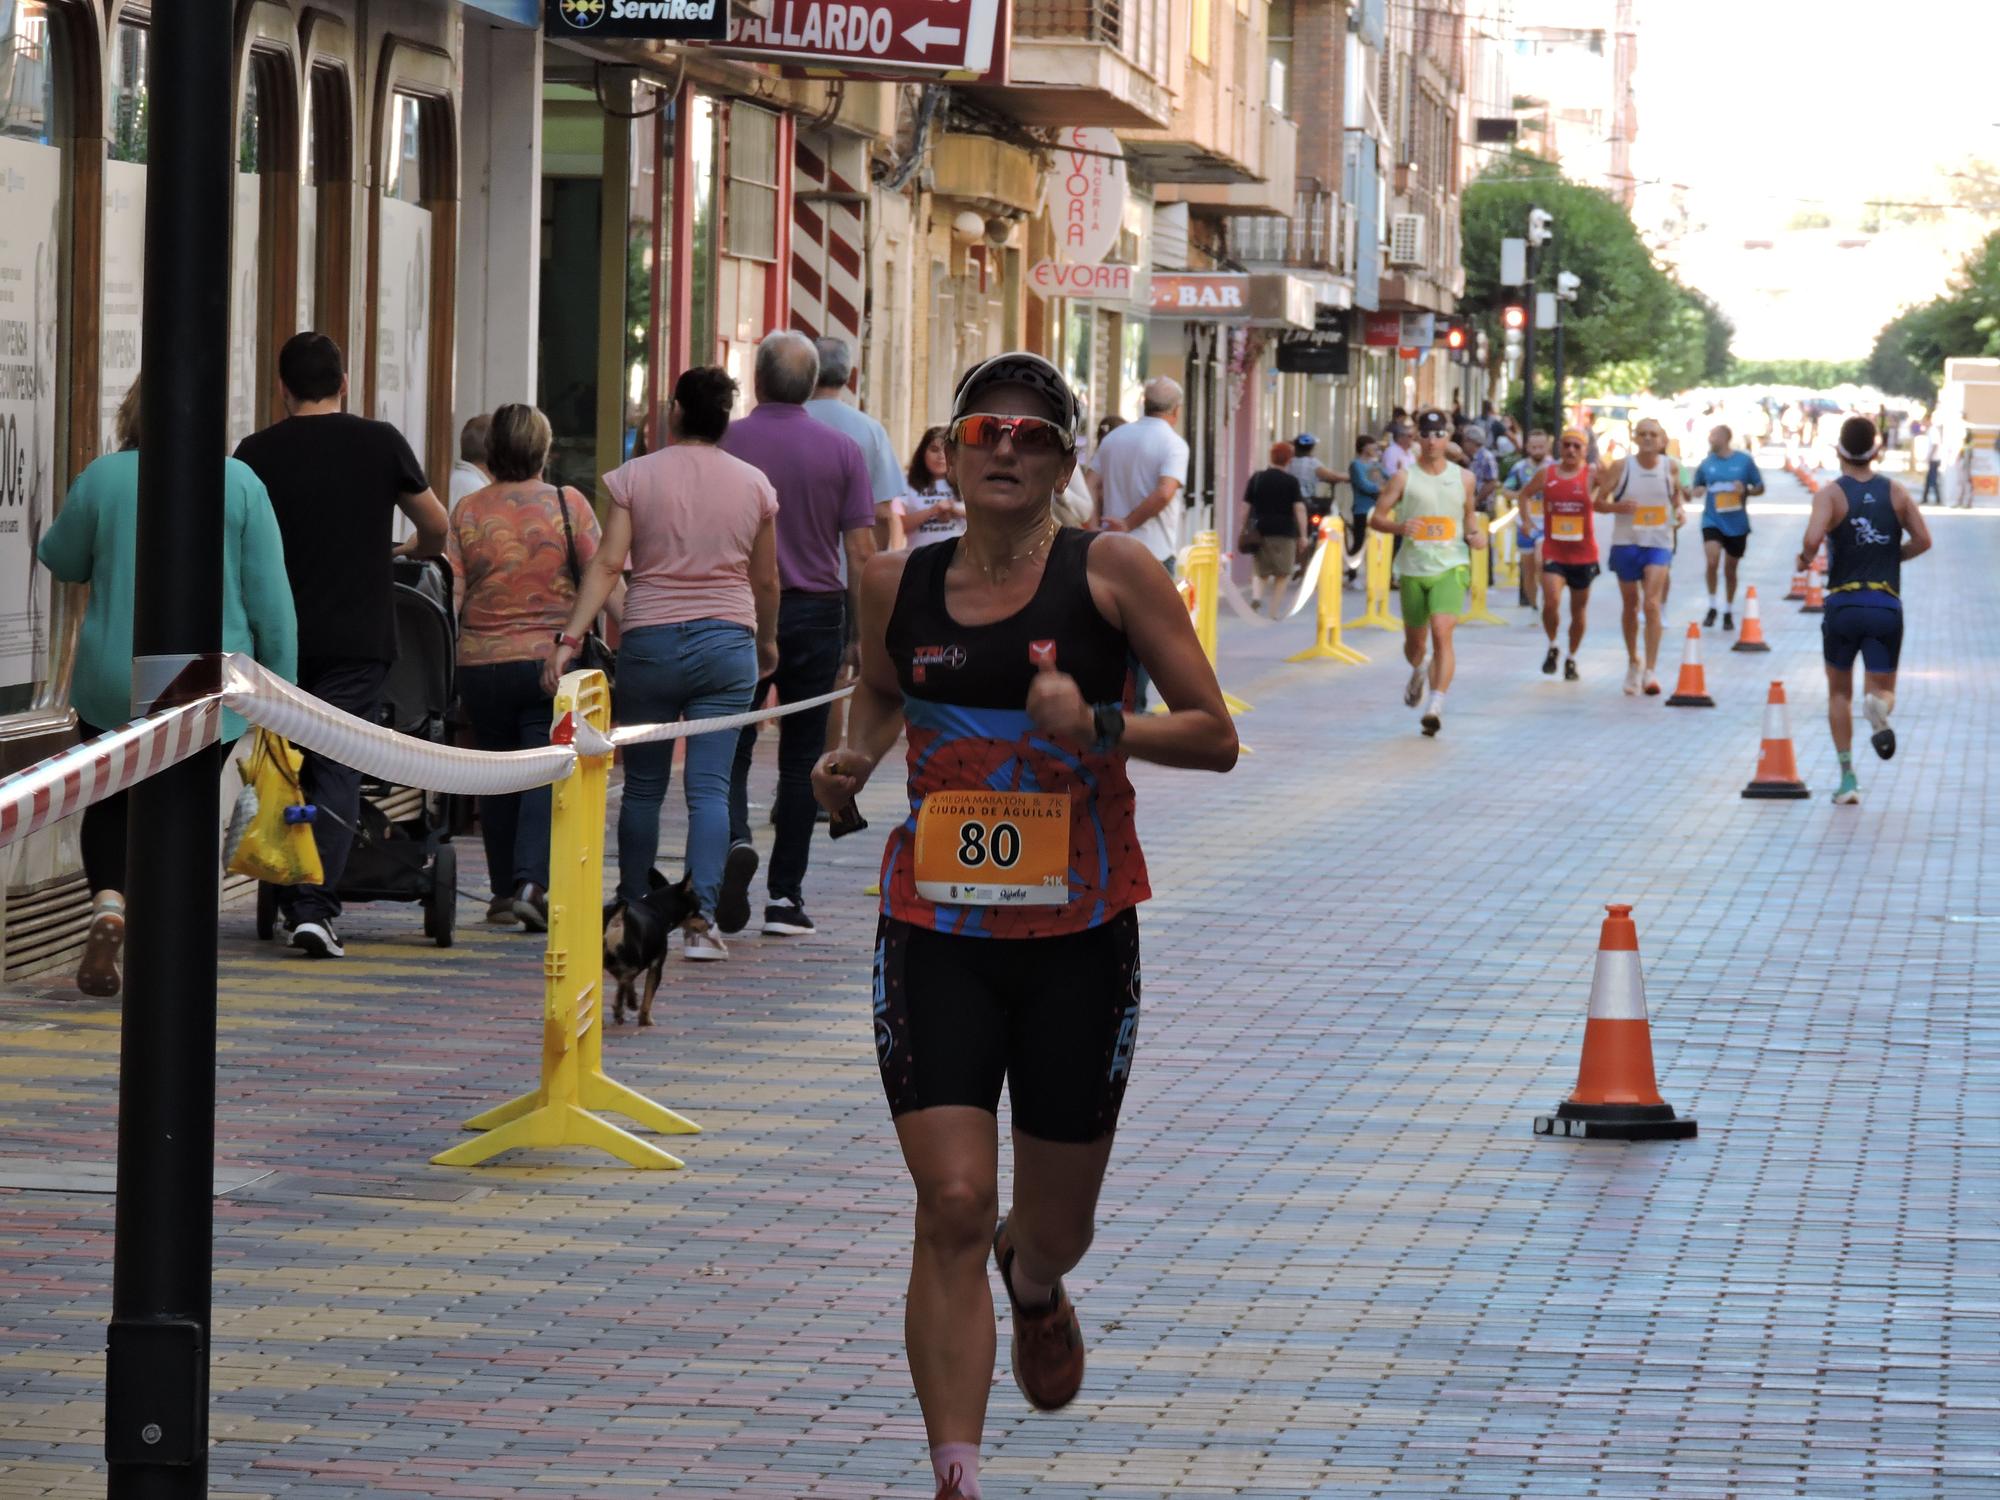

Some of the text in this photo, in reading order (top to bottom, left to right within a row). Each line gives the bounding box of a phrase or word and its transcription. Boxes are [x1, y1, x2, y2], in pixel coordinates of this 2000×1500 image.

[610, 0, 714, 21] ServiRed
[1066, 126, 1089, 246] EVORA
[1035, 264, 1130, 289] EVORA
[1178, 286, 1242, 308] BAR
[929, 804, 976, 816] CIUDAD
[981, 806, 997, 817] DE
[957, 820, 1022, 870] 80
